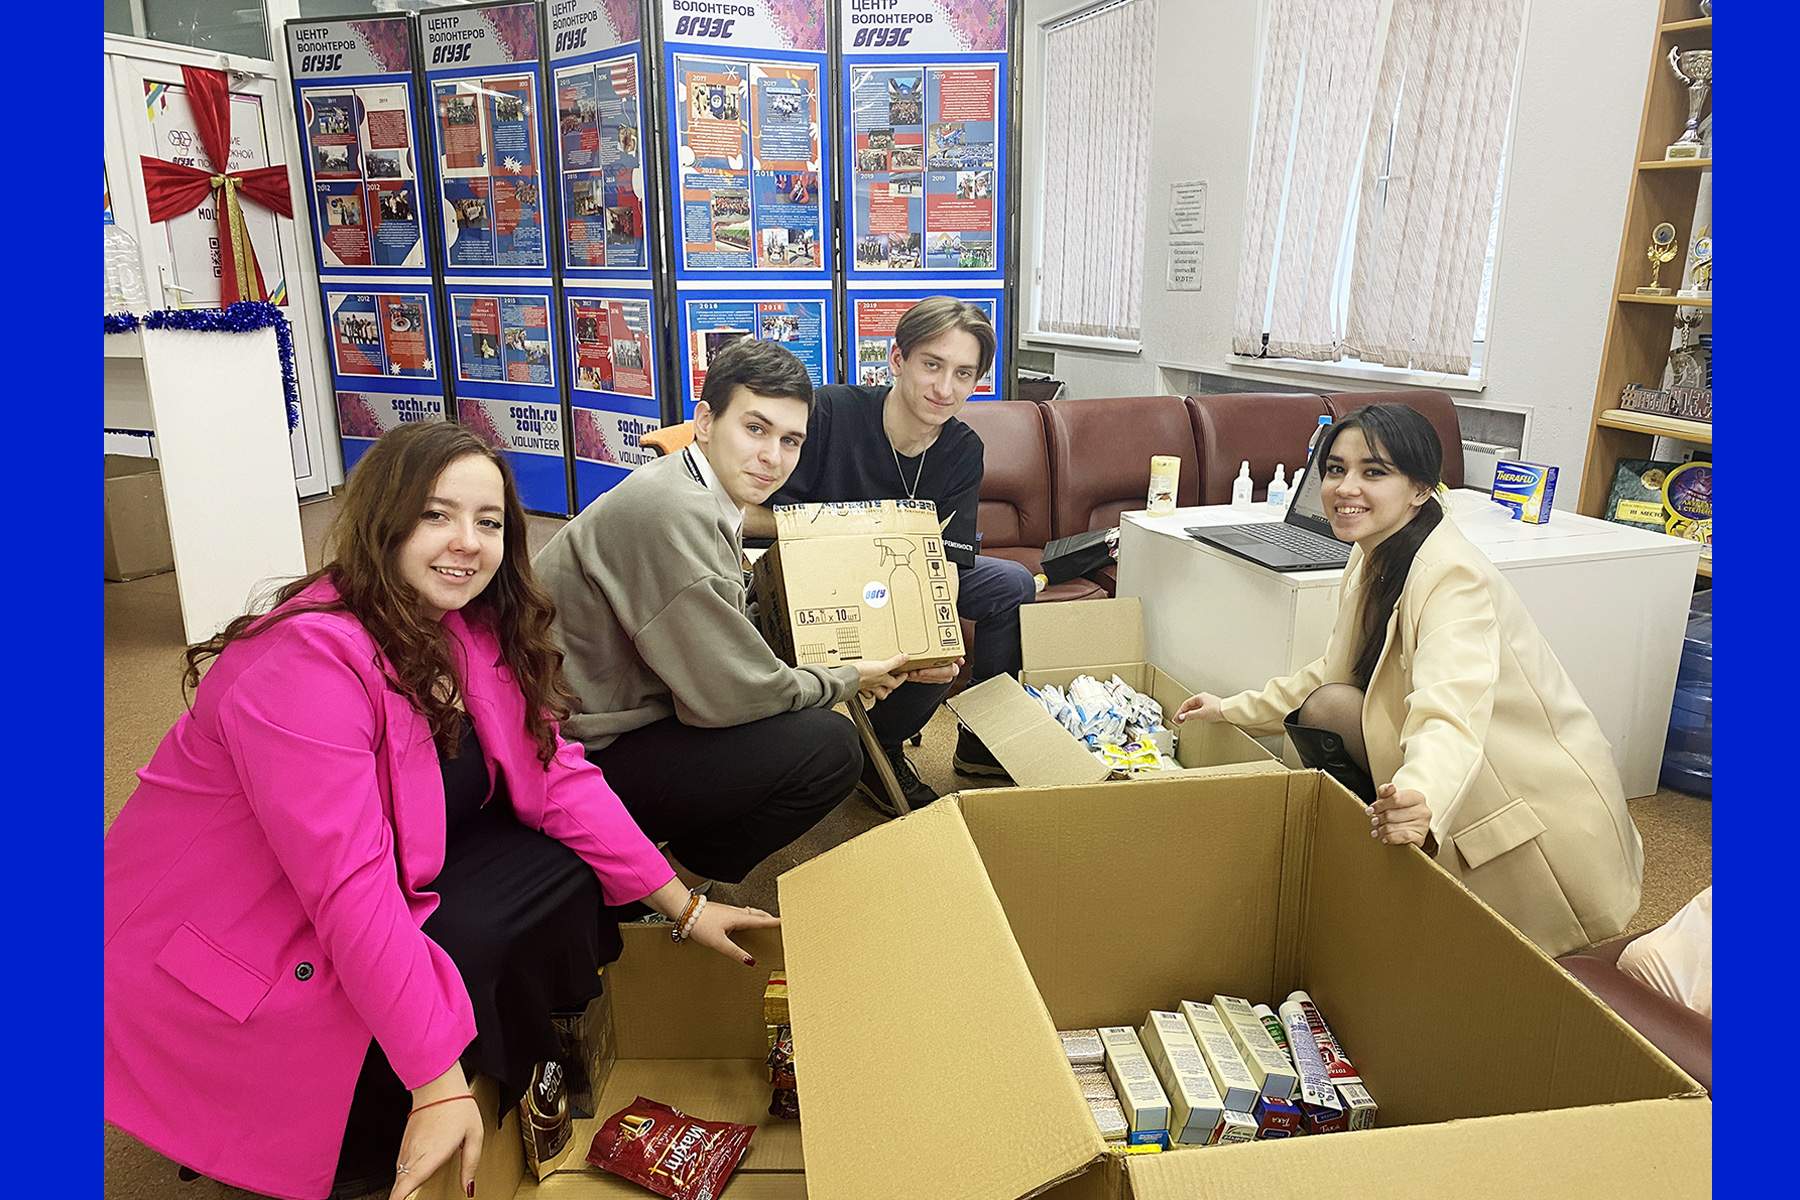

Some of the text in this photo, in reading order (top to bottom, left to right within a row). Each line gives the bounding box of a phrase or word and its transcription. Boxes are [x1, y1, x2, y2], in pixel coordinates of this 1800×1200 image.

[552, 0, 577, 17] ЦЕНТР
[673, 0, 755, 17] ВОЛОНТЕРОВ
[852, 0, 898, 12] ЦЕНТР
[427, 16, 460, 31] ЦЕНТР
[552, 10, 598, 30] ВОЛОНТЕРОВ
[852, 13, 934, 24] ВОЛОНТЕРОВ
[296, 28, 329, 41] ЦЕНТР
[675, 15, 736, 39] ВГУЭС
[429, 28, 485, 43] ВОЛОНТЕРОВ
[555, 27, 588, 53] ВГУЭС
[853, 27, 913, 47] ВГУЭС
[297, 40, 356, 53] ВОЛОНТЕРОВ
[432, 43, 472, 64] ВГУЭС
[302, 54, 343, 72] ВГУЭС
[316, 184, 331, 192] 2012
[366, 183, 381, 191] 2012
[391, 397, 441, 413] sochi.ru
[509, 405, 557, 422] sochi.ru
[516, 420, 542, 436] 2014
[511, 435, 560, 451] VOLUNTEER
[945, 628, 952, 638] 6
[547, 1064, 563, 1103] GOLD
[663, 1124, 706, 1171] Maxim
